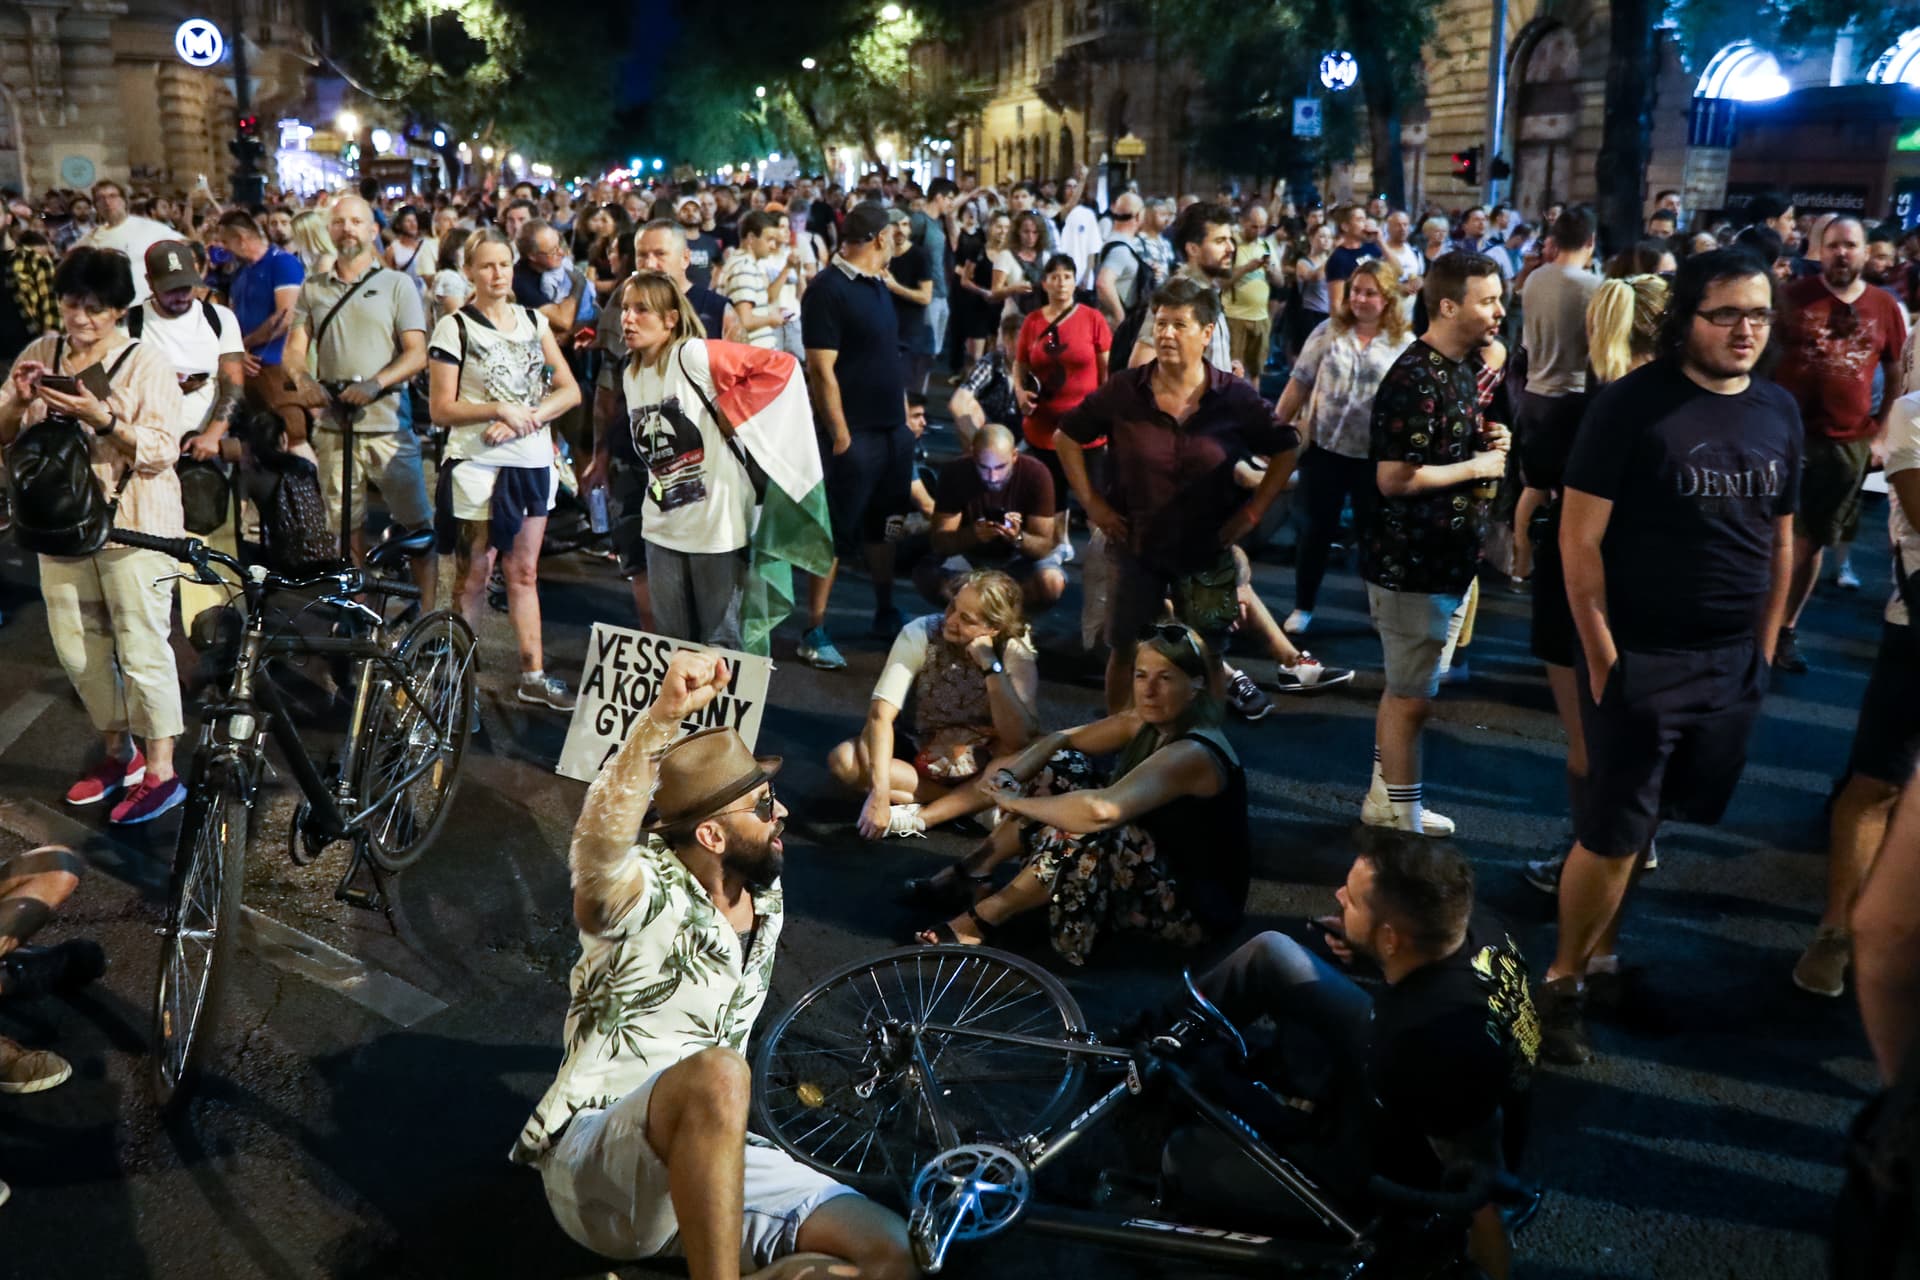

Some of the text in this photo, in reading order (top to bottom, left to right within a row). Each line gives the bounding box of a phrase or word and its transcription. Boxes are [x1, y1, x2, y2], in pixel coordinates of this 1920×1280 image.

[1677, 459, 1779, 497] DENIM
[583, 664, 605, 699] A
[596, 629, 741, 696] VESSN
